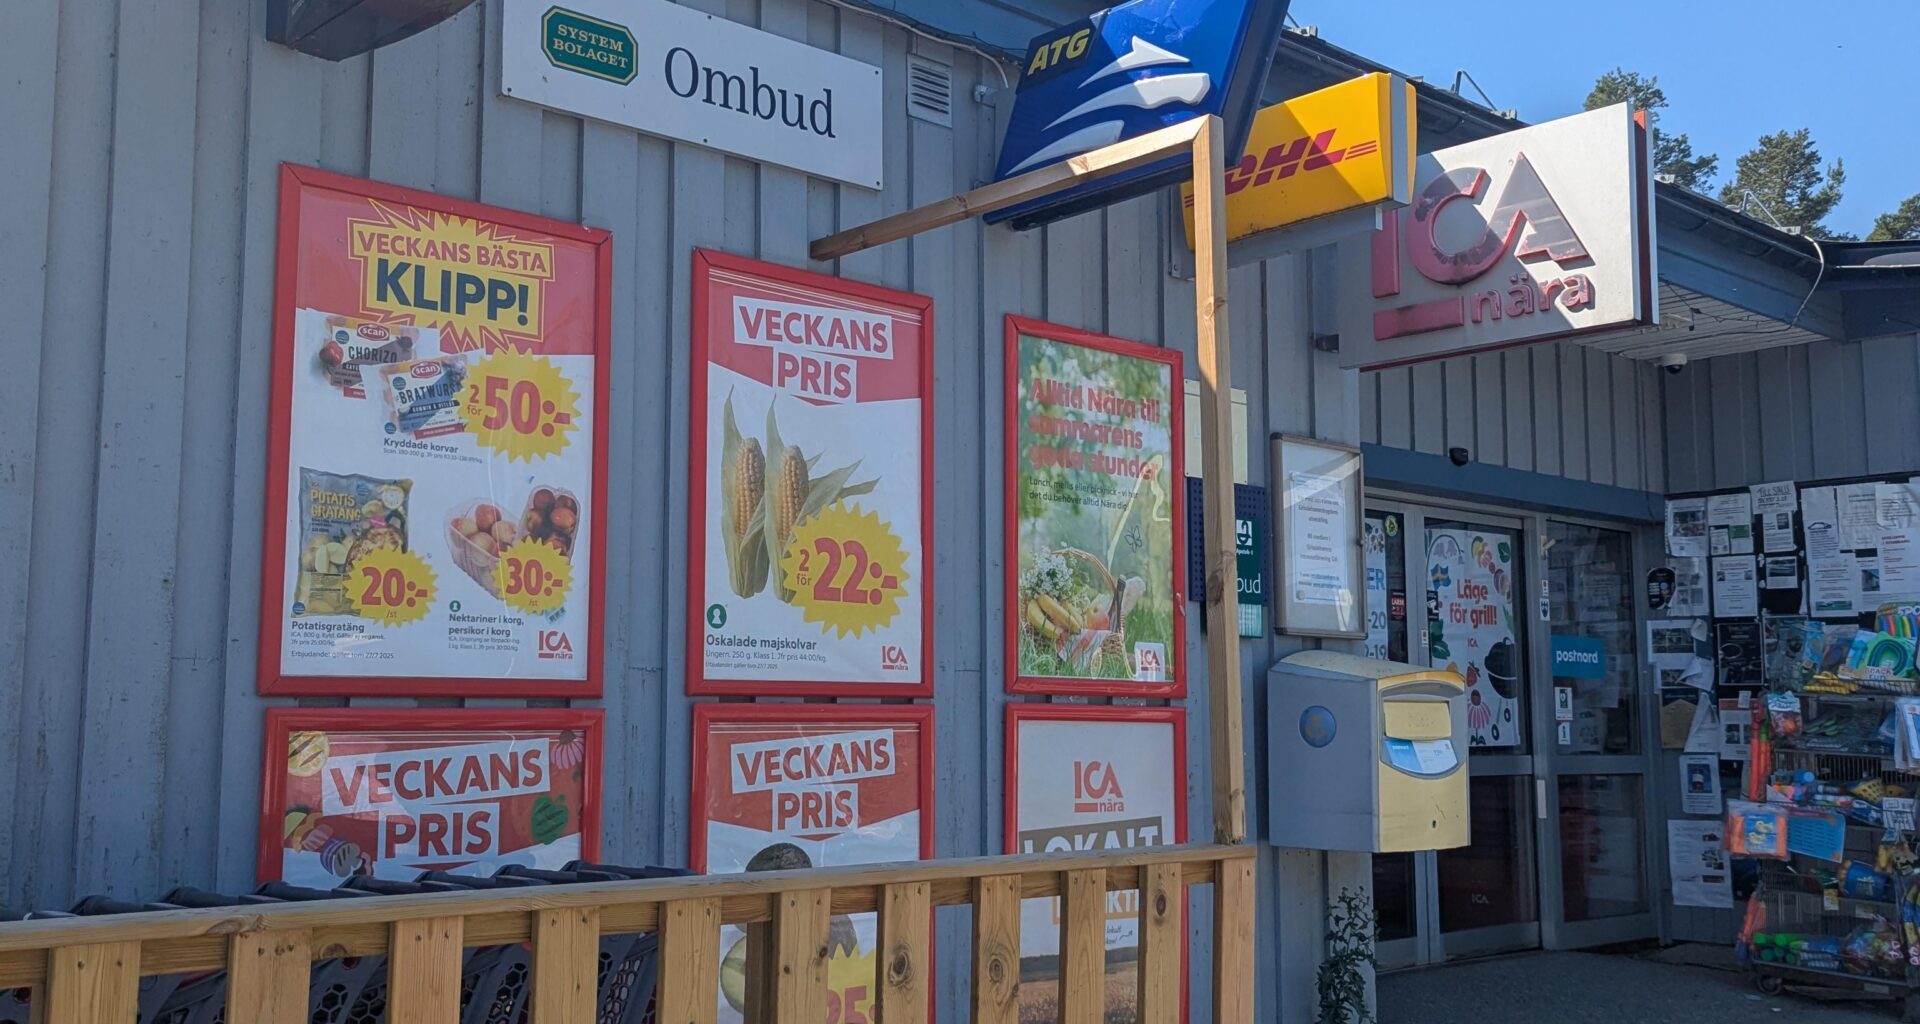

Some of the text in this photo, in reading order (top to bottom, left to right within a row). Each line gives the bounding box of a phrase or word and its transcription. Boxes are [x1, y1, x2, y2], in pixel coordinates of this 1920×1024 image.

[558, 24, 624, 53] SYSTEM
[552, 38, 628, 69] BOLAGET
[1027, 28, 1090, 76] ATG
[664, 46, 836, 138] Ombud
[1224, 128, 1346, 196] DHL
[1371, 151, 1588, 298] ICA
[357, 230, 547, 273] VECKANS BÄSTA
[376, 258, 529, 326] KLIPP!
[1470, 272, 1592, 323] nära
[362, 327, 385, 337] scan
[738, 306, 888, 354] VECKANS
[348, 346, 398, 363] CHORIZO
[415, 365, 437, 374] scan
[778, 352, 852, 399] PRIS
[399, 383, 456, 405] BRATWURS
[470, 384, 480, 403] 2
[482, 376, 571, 437] 50:-
[1029, 378, 1161, 424] Alltid Nära till
[466, 404, 482, 417] för
[1028, 414, 1144, 450] sommarens
[384, 438, 459, 453] Kryddade korvar
[1088, 450, 1158, 481] stunder
[1029, 490, 1042, 501] det
[1043, 492, 1052, 501] du
[1100, 499, 1117, 509] Nära
[799, 549, 810, 572] 2
[814, 537, 898, 606] 22:-
[362, 566, 428, 608] 20:-
[506, 558, 563, 596] 30:-
[796, 573, 812, 586] för
[1457, 578, 1488, 604] Läge
[292, 621, 365, 633] Potatisgratäng
[386, 609, 398, 619] /st
[449, 614, 497, 624] Nektariner
[503, 616, 525, 626] korg,
[1450, 603, 1497, 629] för grill!
[448, 626, 485, 636] persikor
[491, 627, 511, 637] korg
[538, 630, 573, 652] ICA
[706, 634, 817, 651] Oskalade majskolvar
[1467, 638, 1479, 648] ICA
[555, 652, 573, 660] nära
[753, 652, 770, 660] Klass
[786, 653, 798, 661] pris
[882, 646, 908, 665] ICA
[1140, 650, 1160, 666] ICA
[1556, 650, 1598, 664] postnord
[736, 738, 891, 786] VECKANS
[330, 749, 543, 807] VECKANS
[1074, 760, 1124, 800] ICA
[777, 790, 854, 831] PRIS
[1098, 800, 1125, 813] nära
[384, 810, 493, 859] PRIS
[1472, 892, 1489, 905] ICA
